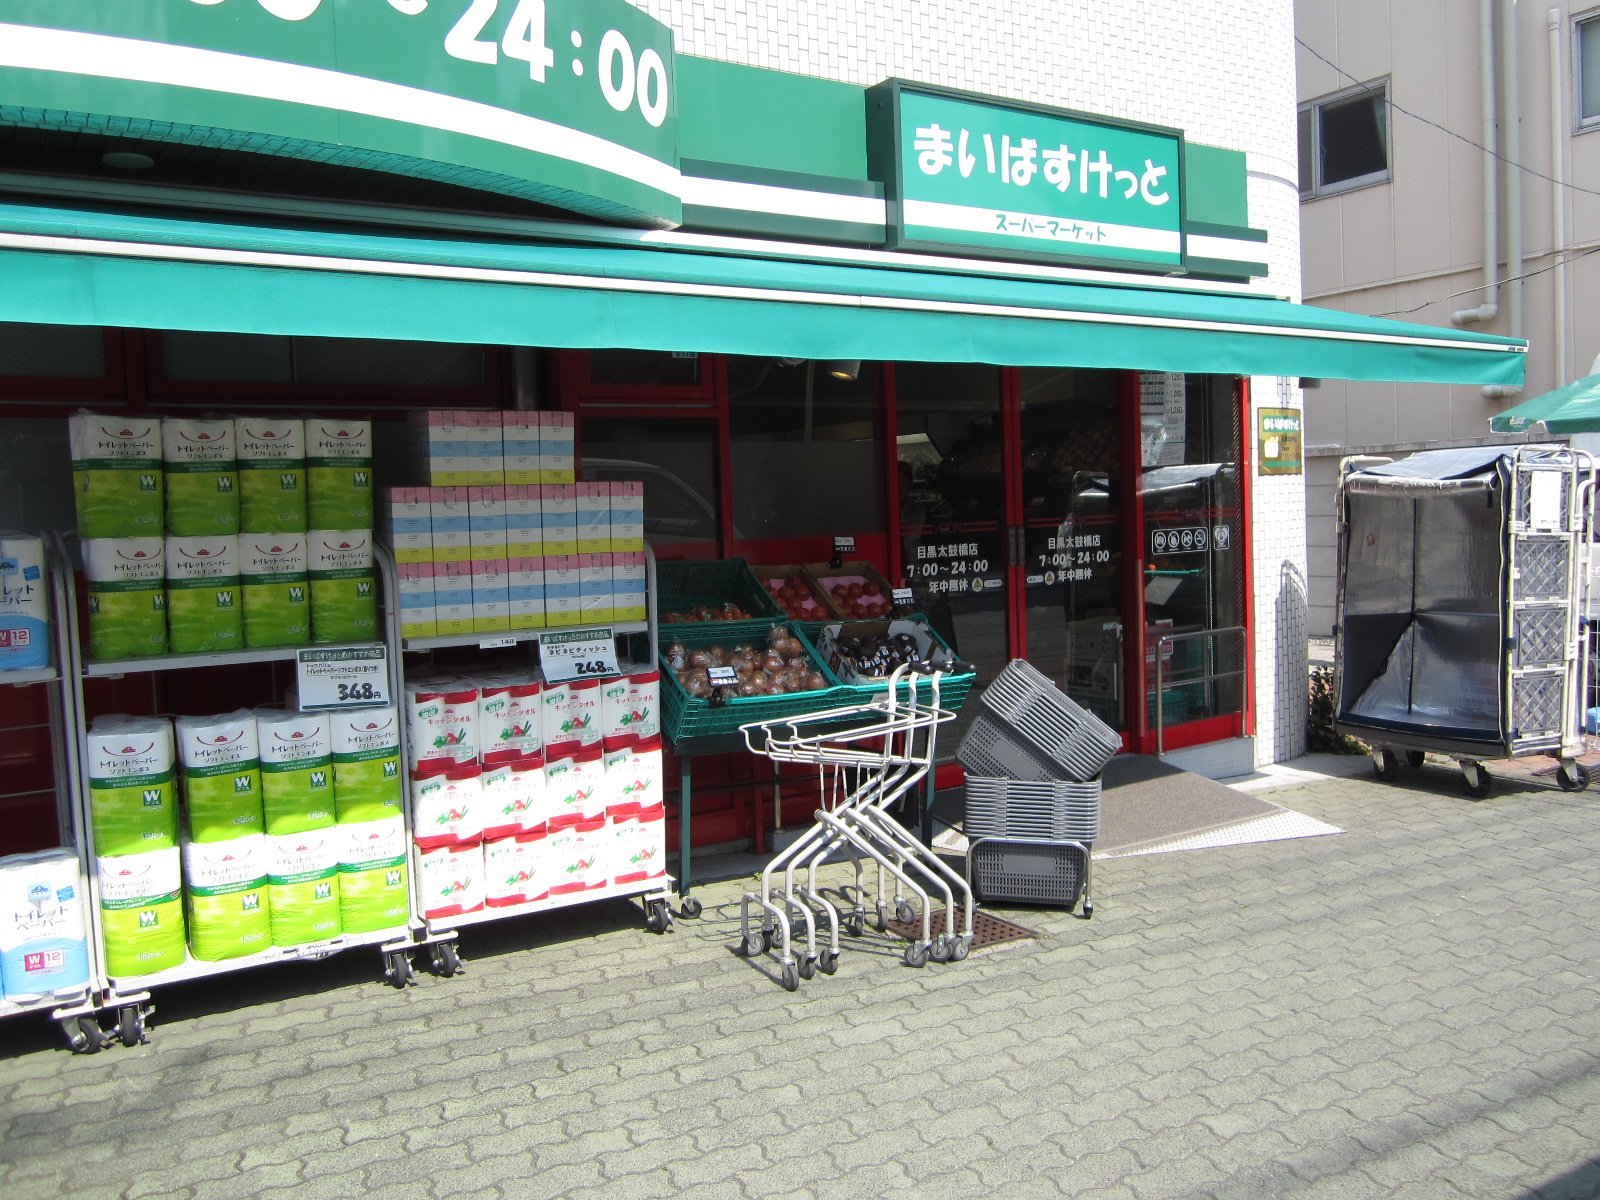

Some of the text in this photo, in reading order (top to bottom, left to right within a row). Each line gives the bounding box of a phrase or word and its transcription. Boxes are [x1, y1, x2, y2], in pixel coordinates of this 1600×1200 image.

[914, 123, 1170, 206] まいばすけっと
[995, 214, 1107, 242] スーパーマーケット
[141, 476, 155, 485] W
[217, 477, 232, 487] W
[281, 474, 296, 484] W
[354, 472, 367, 482] W
[1048, 535, 1101, 549] 目黒太鼓橋店
[917, 543, 978, 559] 目黒太鼓橋店
[253, 557, 302, 565] トイレットペーパー
[321, 553, 369, 561] トイレットペーパー
[114, 563, 163, 571] トイレットペーパー
[178, 561, 231, 569] トイレットペーパー
[1057, 568, 1093, 582] 年中無休
[357, 583, 371, 592] W
[929, 578, 969, 593] 年中無休
[289, 587, 303, 597] W
[217, 592, 232, 603] W
[12, 631, 28, 640] 12
[500, 638, 515, 646] 148
[574, 661, 614, 674] 248円
[338, 683, 381, 701] 348円
[615, 695, 654, 704] キッチンタオル
[555, 701, 595, 710] キッチンタオル
[494, 709, 536, 718] キッチンタオル
[428, 716, 471, 725] キッチンタオル
[348, 732, 395, 743] トイレットペーパー
[272, 742, 324, 752] トイレットペーパー
[357, 740, 389, 748] ソフトエンボス
[195, 745, 248, 757] トイレットペーパー
[281, 750, 316, 758] ソフトエンボス
[100, 757, 159, 768] トイレットペーパー
[204, 754, 241, 763] ソフトエンボス
[110, 767, 150, 775] ソフトエンボス
[383, 761, 396, 771] W
[234, 777, 250, 787] W
[310, 772, 325, 782] W
[143, 790, 161, 801] W
[386, 871, 400, 882] W
[315, 883, 330, 894] W
[242, 895, 258, 905] W
[15, 906, 68, 922] トイレット
[139, 911, 157, 922] W
[17, 919, 66, 931] ペーパー
[28, 954, 41, 965] W
[46, 952, 61, 961] 12
